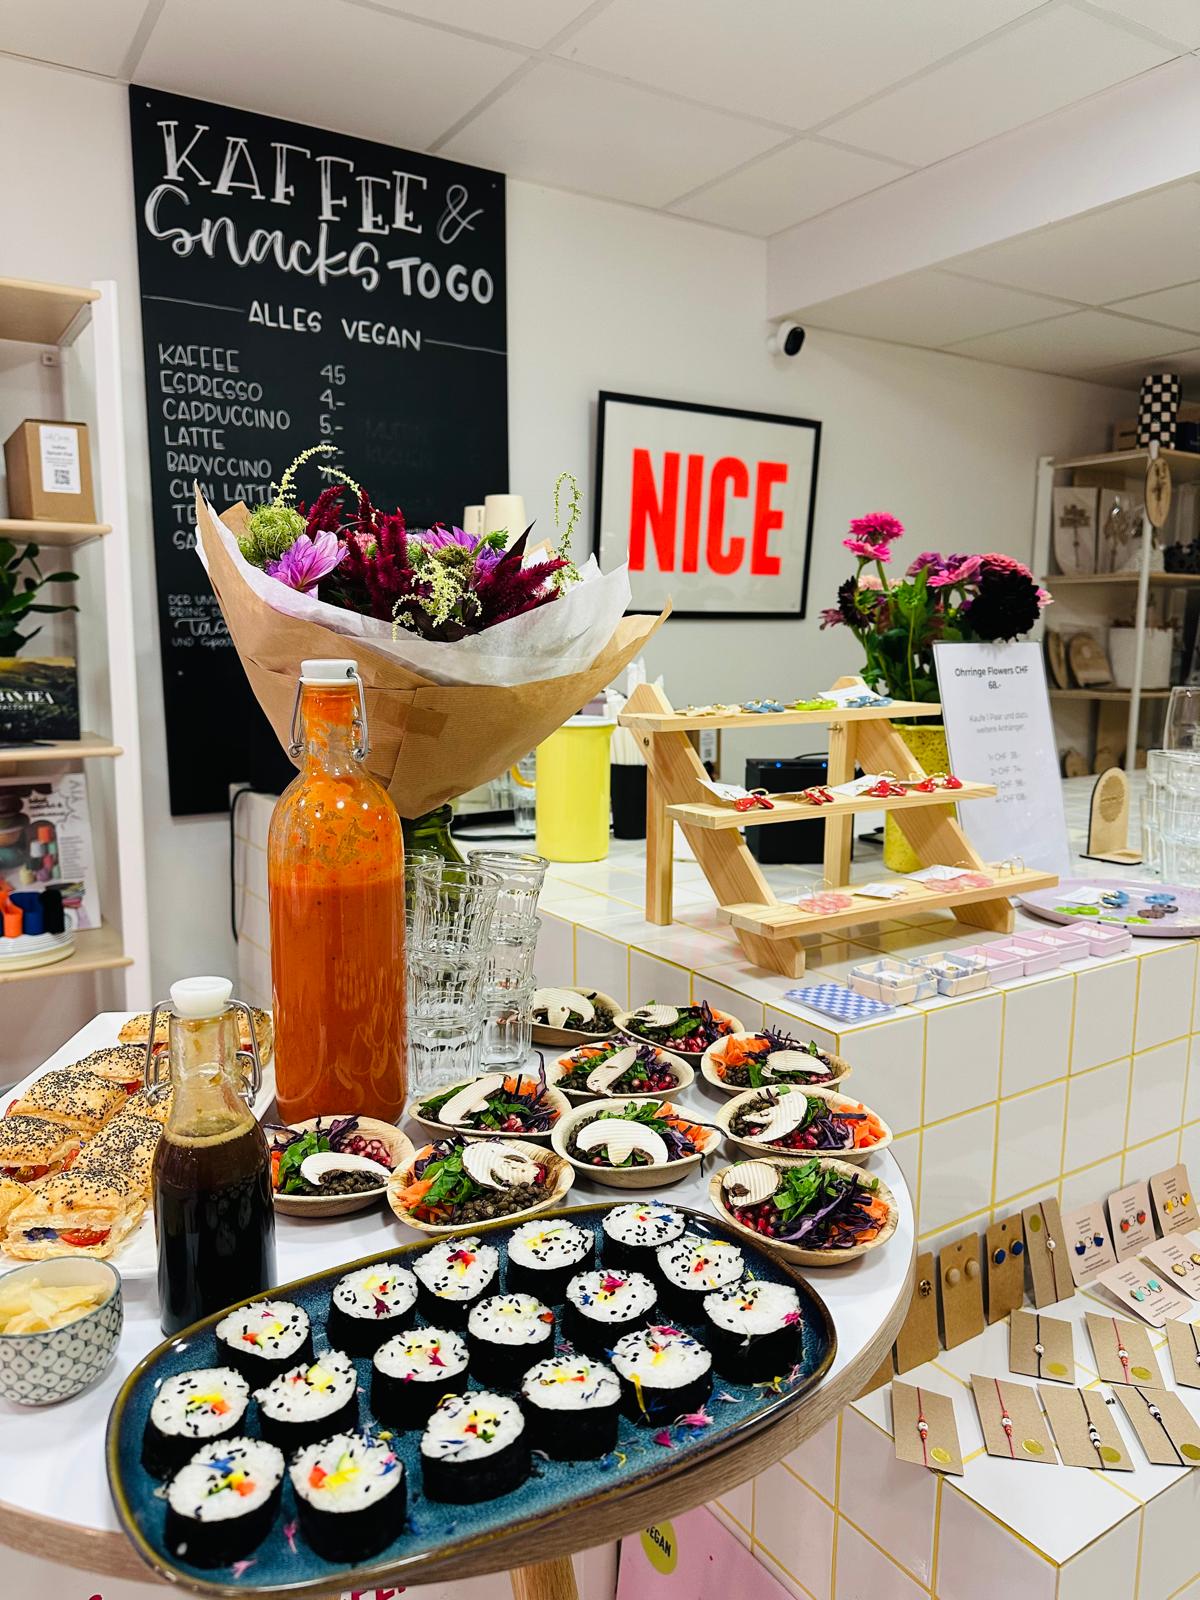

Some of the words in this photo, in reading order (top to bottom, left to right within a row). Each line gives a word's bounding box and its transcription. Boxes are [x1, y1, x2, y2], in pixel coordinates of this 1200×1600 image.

[157, 120, 427, 236] KAFFEE
[436, 184, 484, 244] &
[145, 184, 379, 291] Snacks
[249, 300, 322, 332] ALLES
[341, 318, 421, 350] VEGAN
[158, 343, 239, 373] KAFFEE
[160, 370, 263, 402] ESPRESSO
[162, 397, 290, 430] CAPPUCCINO
[164, 425, 225, 450] LATTE
[166, 450, 272, 479] BABYCCINO
[172, 504, 197, 525] TE
[628, 448, 788, 575] NICE
[172, 530, 197, 550] SA
[954, 667, 986, 678] Ohrringe
[987, 666, 1014, 676] Flowers
[1015, 665, 1029, 674] CHF
[24, 690, 55, 705] TEA
